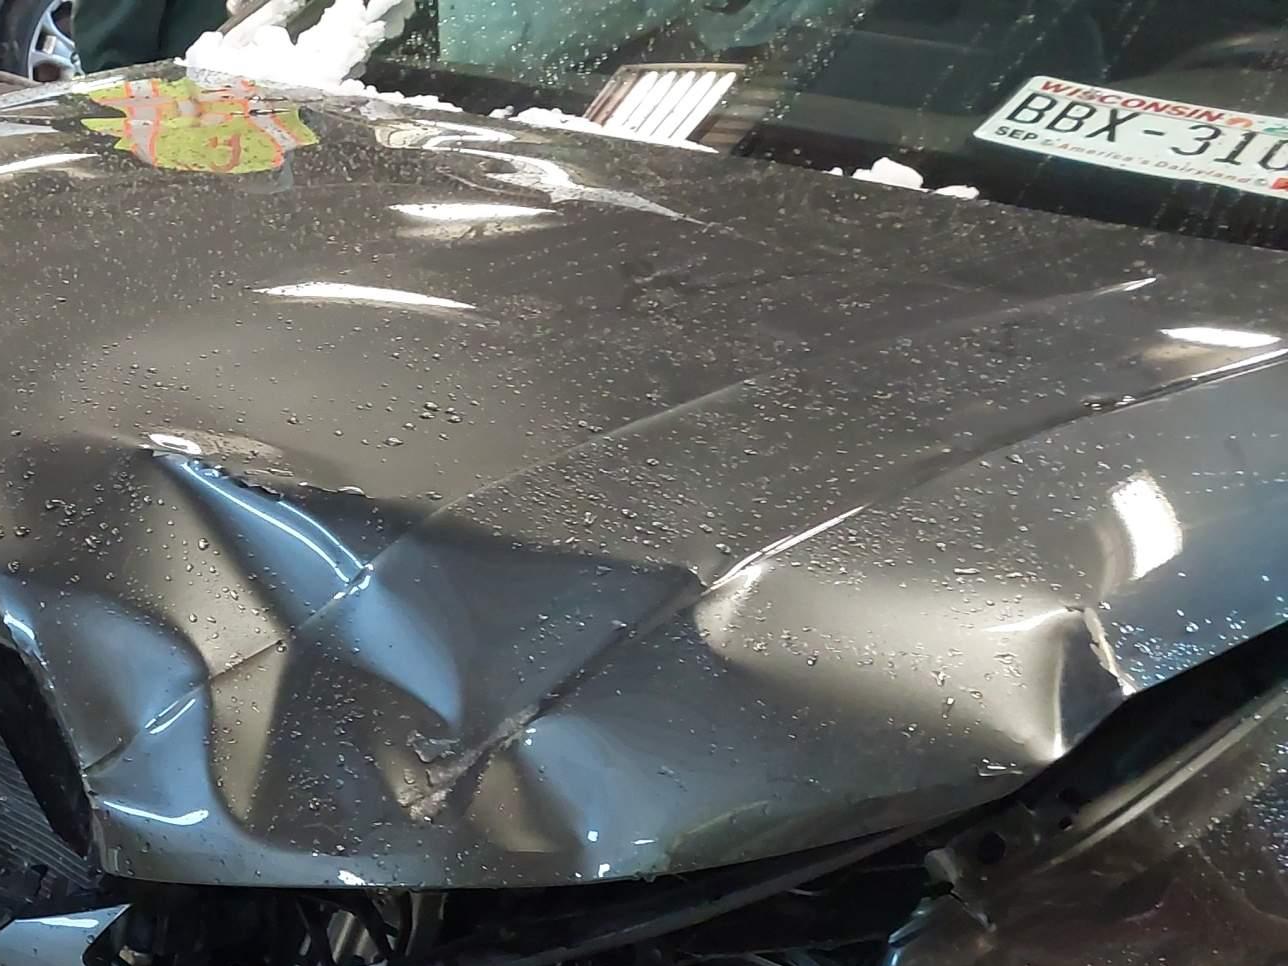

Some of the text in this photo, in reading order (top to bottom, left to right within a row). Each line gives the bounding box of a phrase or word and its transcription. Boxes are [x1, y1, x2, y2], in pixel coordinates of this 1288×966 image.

[1040, 80, 1224, 121] WISCONSIN
[994, 126, 1039, 141] SEP
[1056, 142, 1252, 184] America's Dairyland
